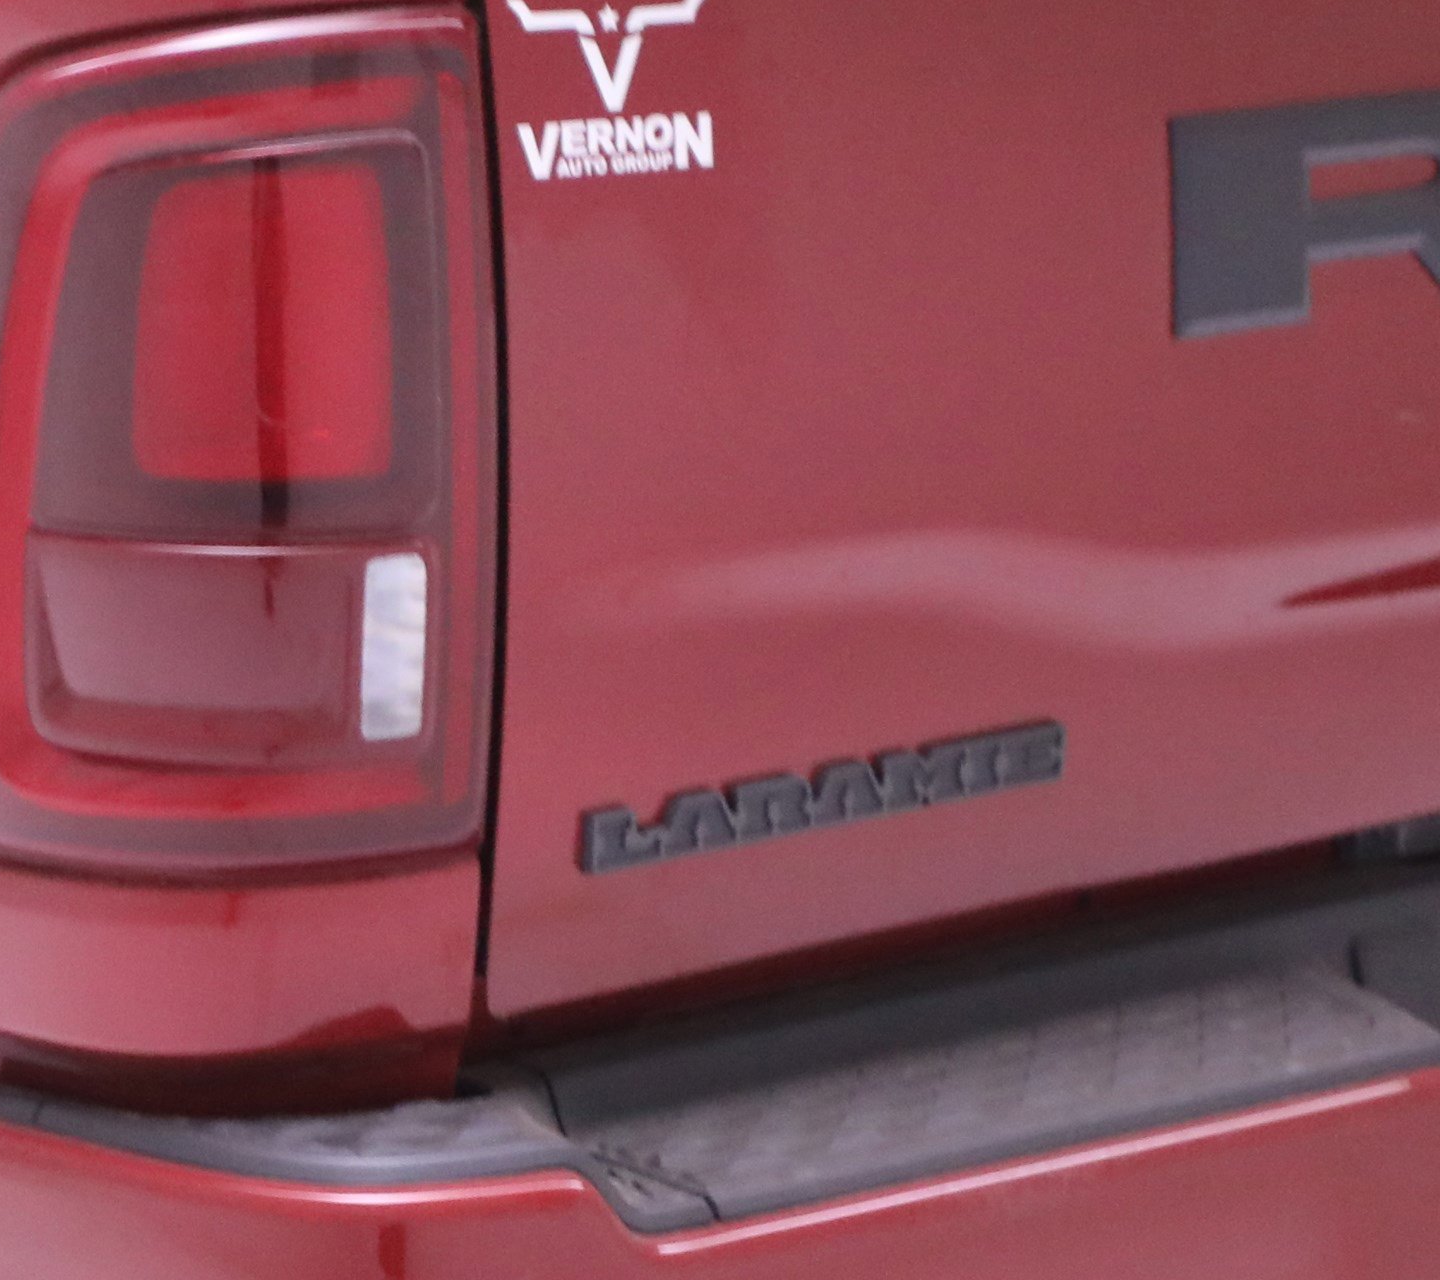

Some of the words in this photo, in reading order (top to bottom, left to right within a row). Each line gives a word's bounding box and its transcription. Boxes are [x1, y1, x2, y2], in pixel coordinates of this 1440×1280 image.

[516, 111, 714, 181] VERNON
[556, 154, 608, 179] AUTO
[612, 151, 673, 175] GROUP
[580, 717, 1066, 875] LARAMIE
